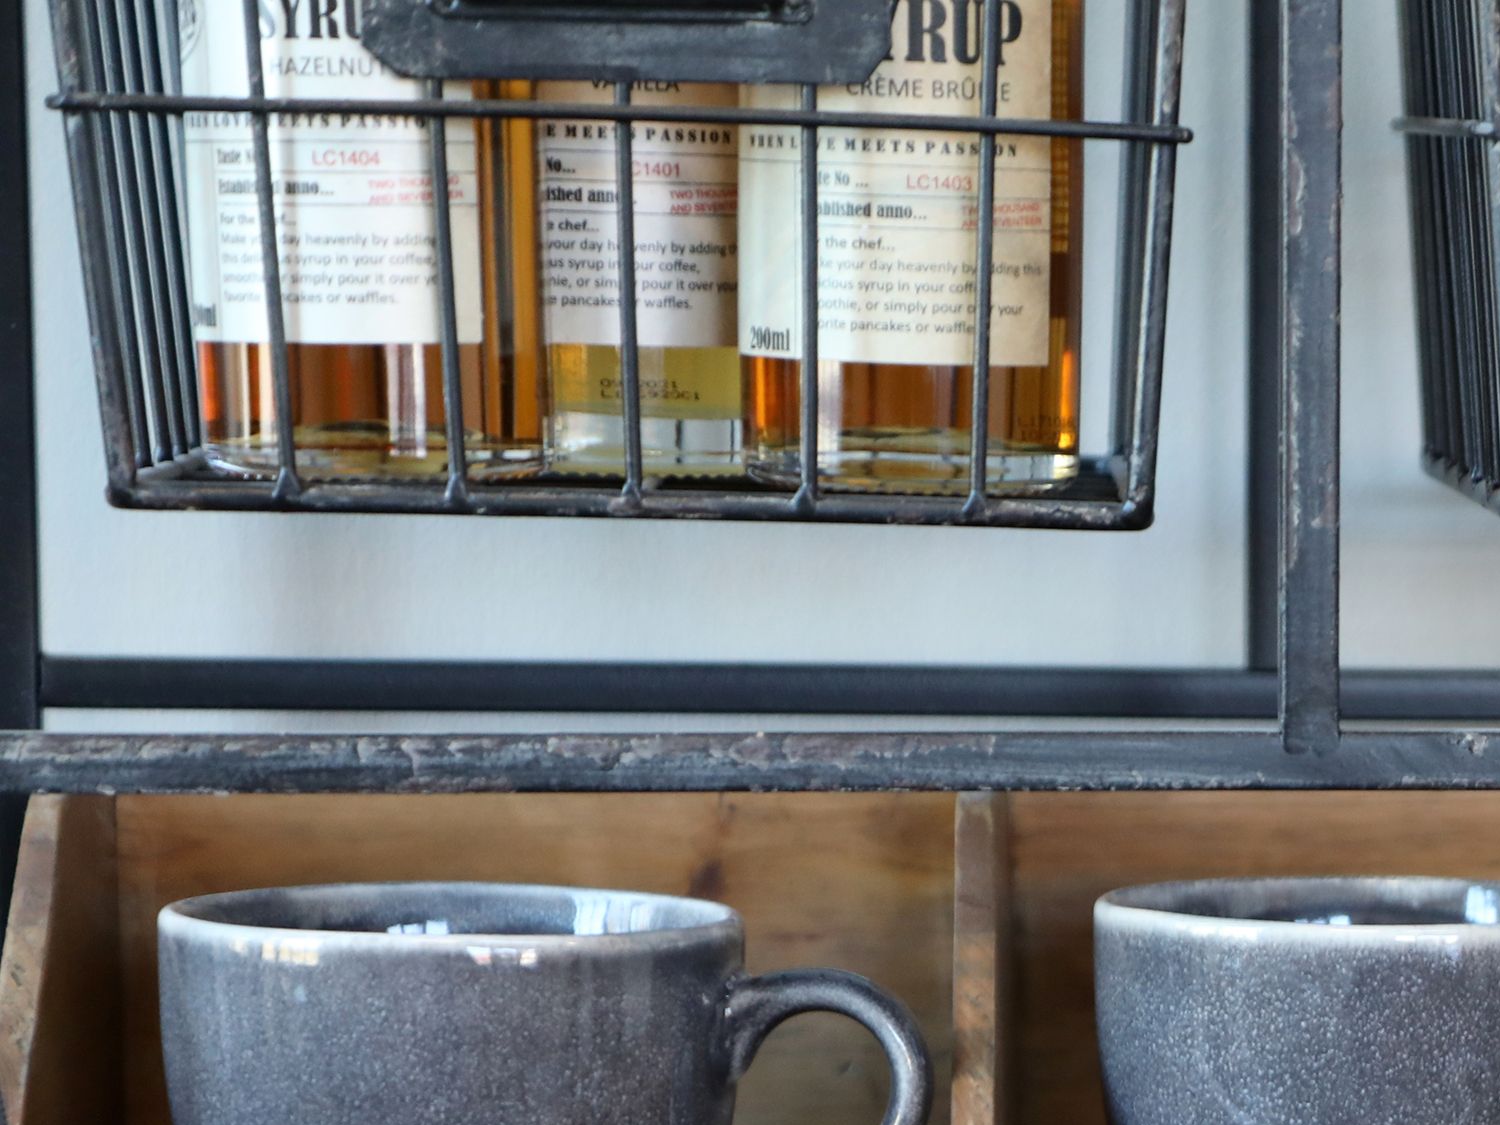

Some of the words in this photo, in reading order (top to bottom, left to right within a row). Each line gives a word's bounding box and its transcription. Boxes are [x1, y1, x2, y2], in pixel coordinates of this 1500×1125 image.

[270, 56, 388, 77] HAZELNU
[591, 80, 681, 92] VAILLA
[932, 76, 1011, 101] BRÛE
[266, 112, 329, 128] EETS
[340, 112, 427, 129] PASSIO
[645, 128, 732, 145] PASSION
[844, 138, 916, 153] MEETS
[925, 140, 1017, 158] PASSON
[311, 148, 380, 167] LC1404
[632, 161, 681, 178] C1401
[906, 173, 973, 192] LC1403
[304, 232, 368, 248] heavenly
[371, 232, 389, 248] by
[580, 238, 602, 253] day
[670, 240, 689, 255] by
[689, 241, 728, 257] adding
[825, 235, 848, 249] the
[352, 254, 384, 268] your
[568, 257, 604, 272] syrup
[635, 262, 655, 271] our
[658, 260, 700, 275] coffee,
[869, 260, 894, 273] day
[897, 259, 957, 274] heavenly
[1023, 264, 1042, 275] this
[337, 273, 370, 287] pour
[388, 273, 421, 284] over
[577, 277, 589, 289] or
[641, 279, 673, 292] pour
[676, 278, 686, 291] it
[688, 280, 715, 292] over
[857, 281, 894, 294] syrup
[897, 280, 911, 292] in
[914, 282, 945, 296] your
[326, 293, 341, 304] or
[865, 301, 879, 311] or
[883, 301, 928, 317] simply
[931, 302, 963, 315] pour
[997, 304, 1025, 317] your
[850, 318, 912, 333] pancakes
[915, 322, 930, 333] or
[934, 321, 976, 335] waffle
[750, 324, 790, 351] 200ml
